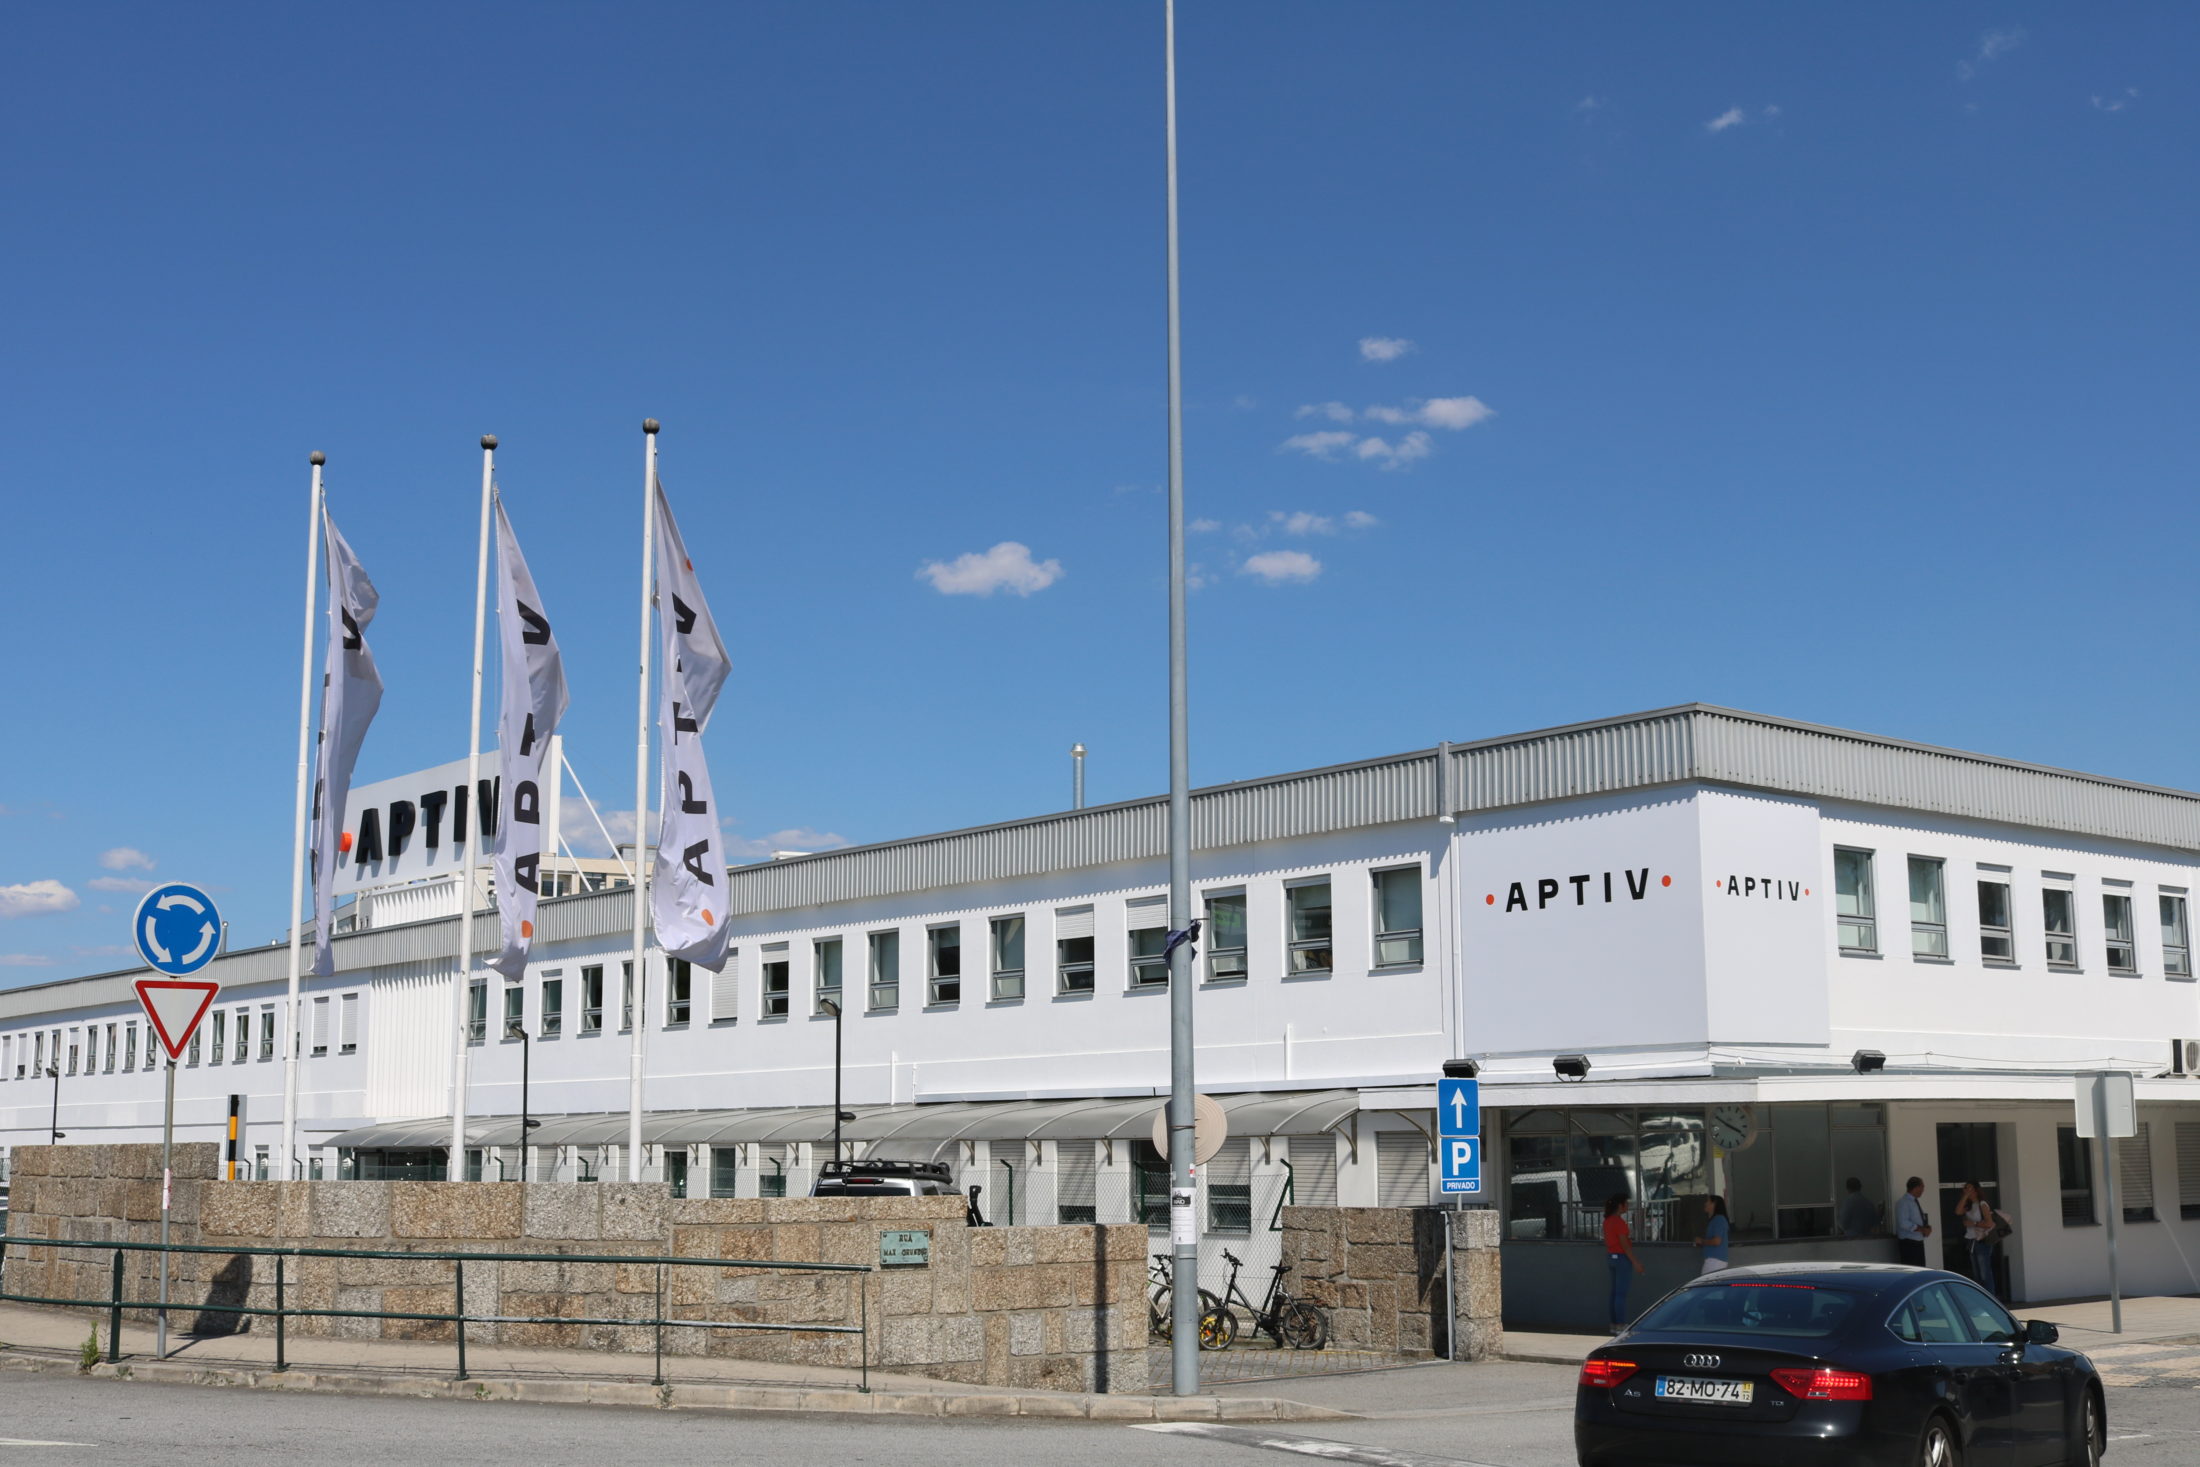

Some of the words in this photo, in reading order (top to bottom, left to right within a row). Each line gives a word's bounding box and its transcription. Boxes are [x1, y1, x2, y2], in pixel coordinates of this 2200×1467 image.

[671, 592, 714, 887] APTV
[355, 775, 500, 864] APTIV
[1505, 867, 1649, 913] APTIV
[1727, 875, 1800, 901] APTIV
[1452, 1141, 1471, 1176] P
[1446, 1181, 1476, 1190] PRIVADO
[899, 1234, 913, 1243] RUA
